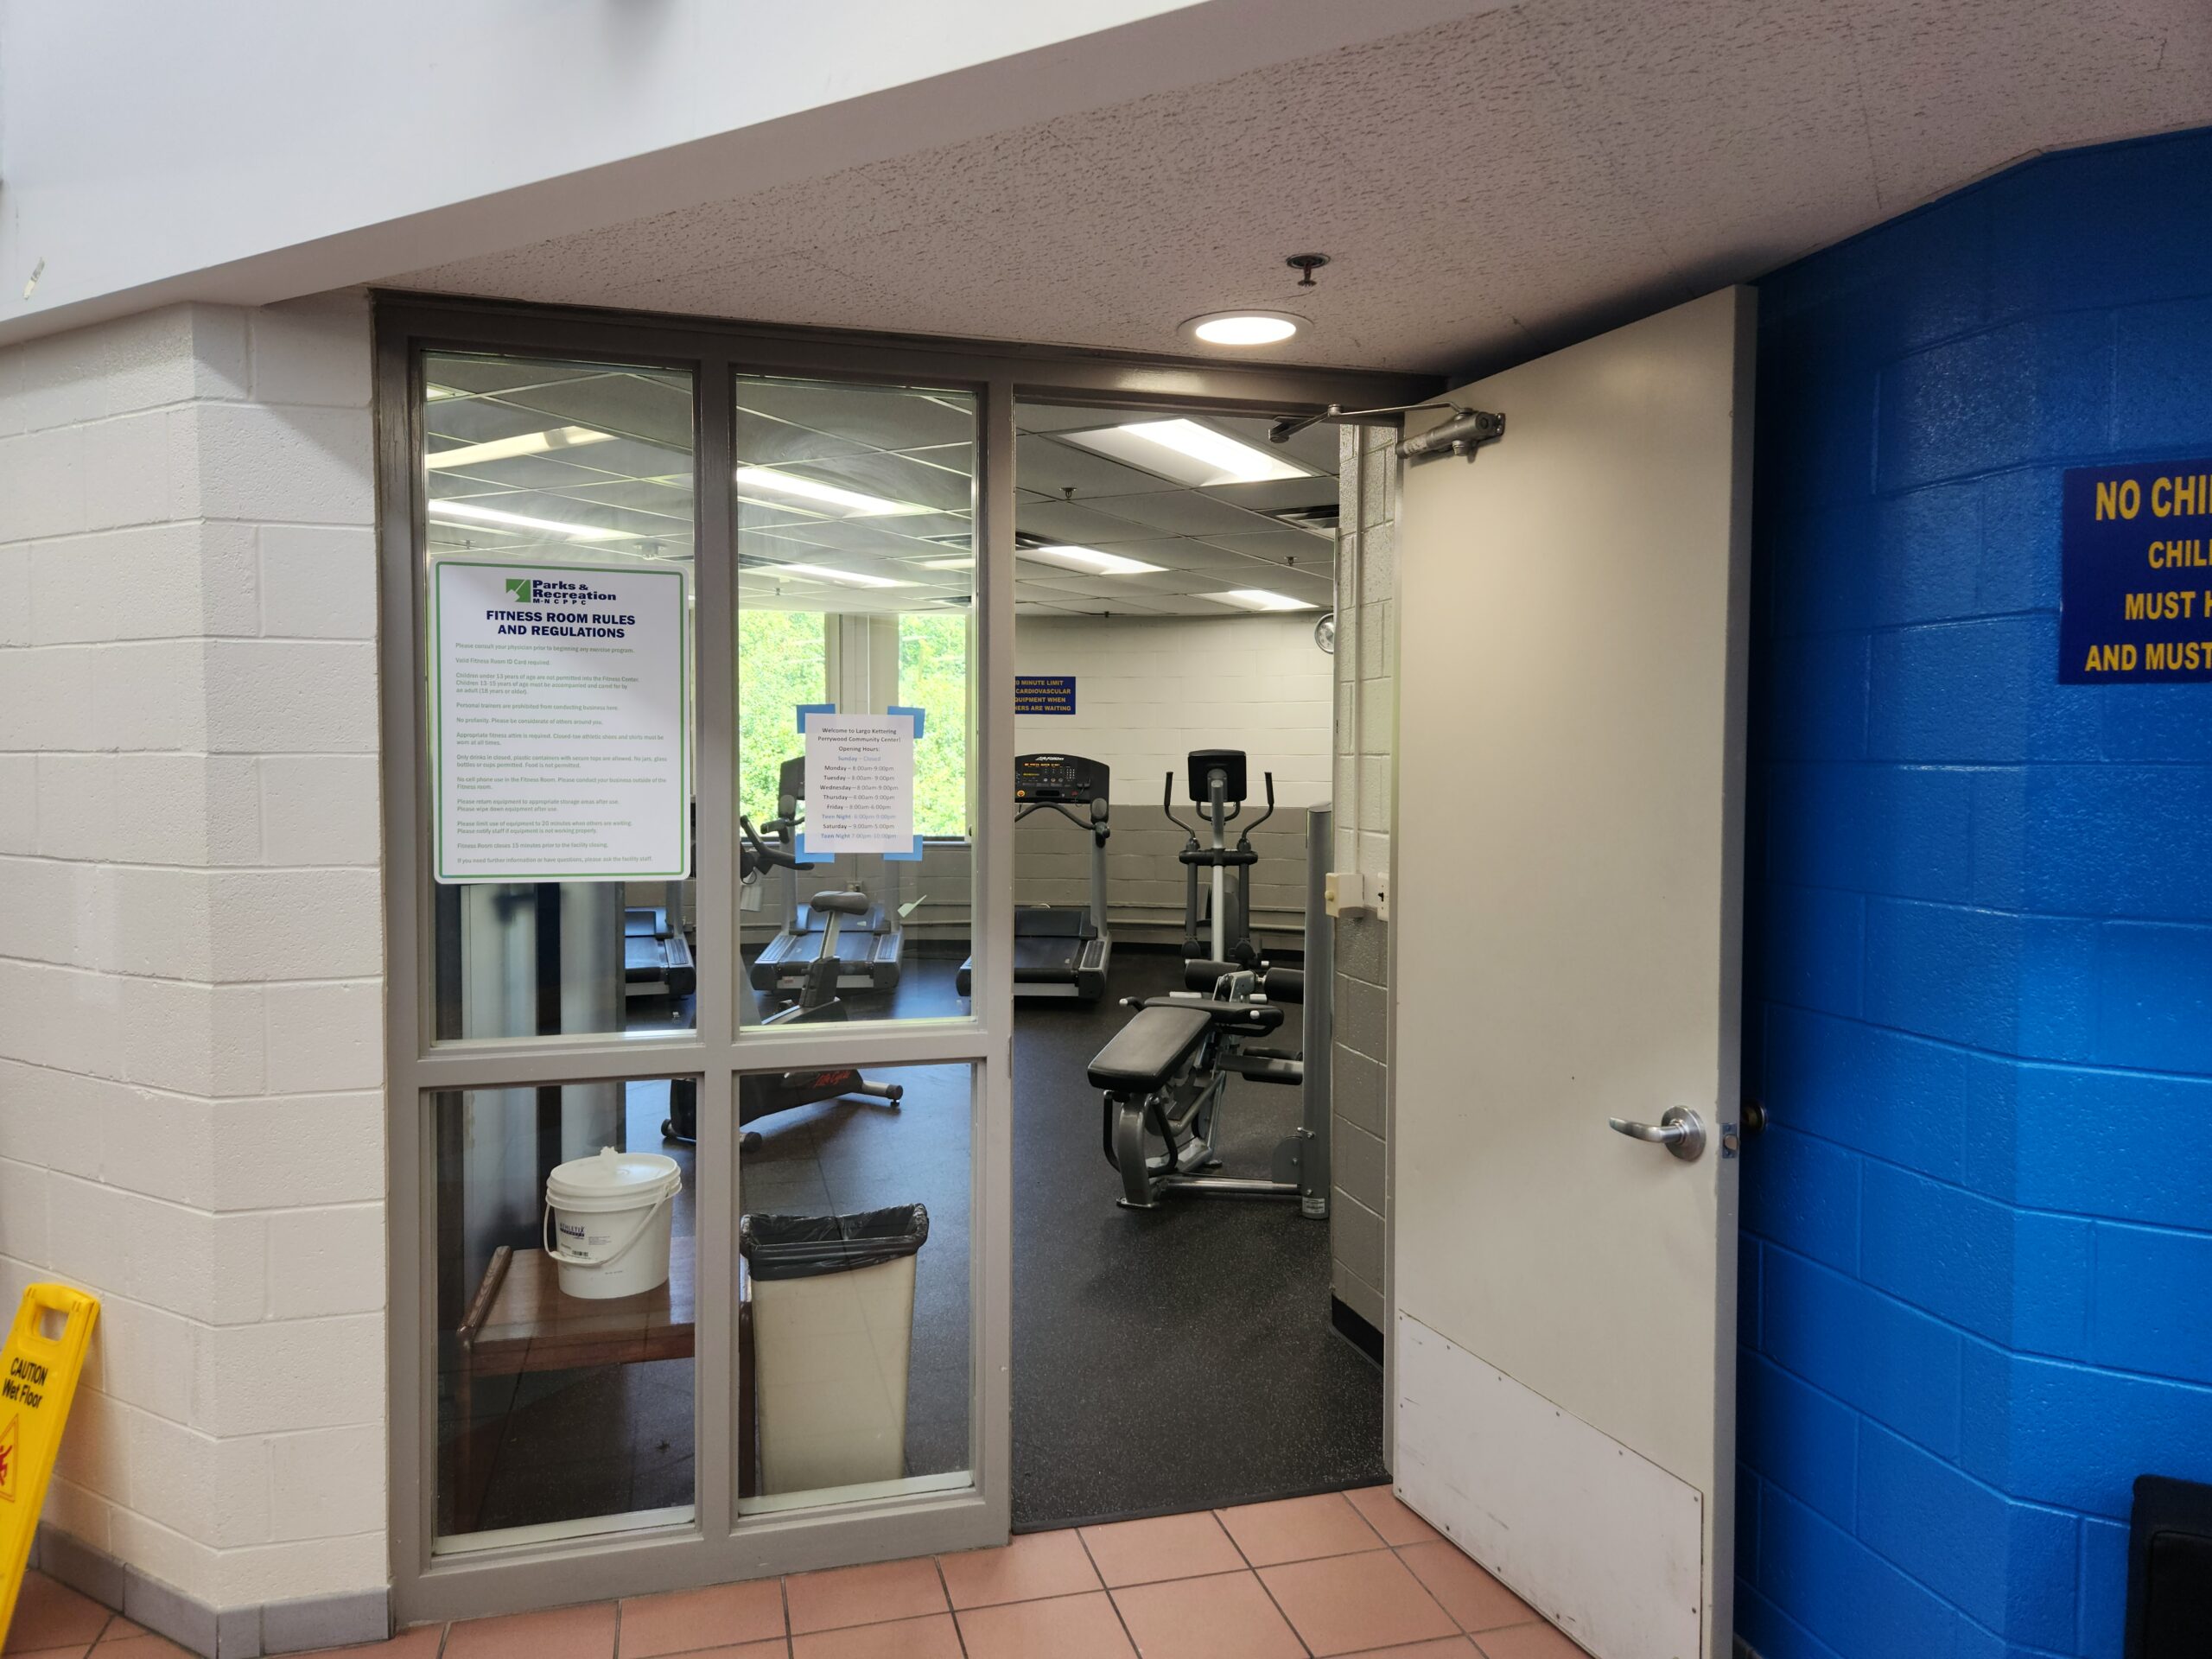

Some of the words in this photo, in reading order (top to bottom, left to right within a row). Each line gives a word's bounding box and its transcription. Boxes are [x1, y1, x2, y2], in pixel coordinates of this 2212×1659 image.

[2095, 480, 2141, 520] NO
[2152, 474, 2212, 518] CHI
[2148, 539, 2212, 569] CHIL
[532, 580, 576, 590] Parks
[578, 582, 589, 591] &
[532, 589, 616, 600] Recreation
[486, 611, 543, 622] FITNESS
[547, 612, 588, 623] ROOM
[592, 614, 636, 624] RULES
[2125, 591, 2196, 620] MUST
[498, 625, 527, 635] AND
[531, 625, 625, 638] REGULATIONS
[2085, 644, 2138, 671] AND
[2145, 642, 2212, 671] MUST
[10, 1357, 48, 1386] CAUTION
[2, 1377, 20, 1401] Wet
[19, 1384, 43, 1409] Floor
